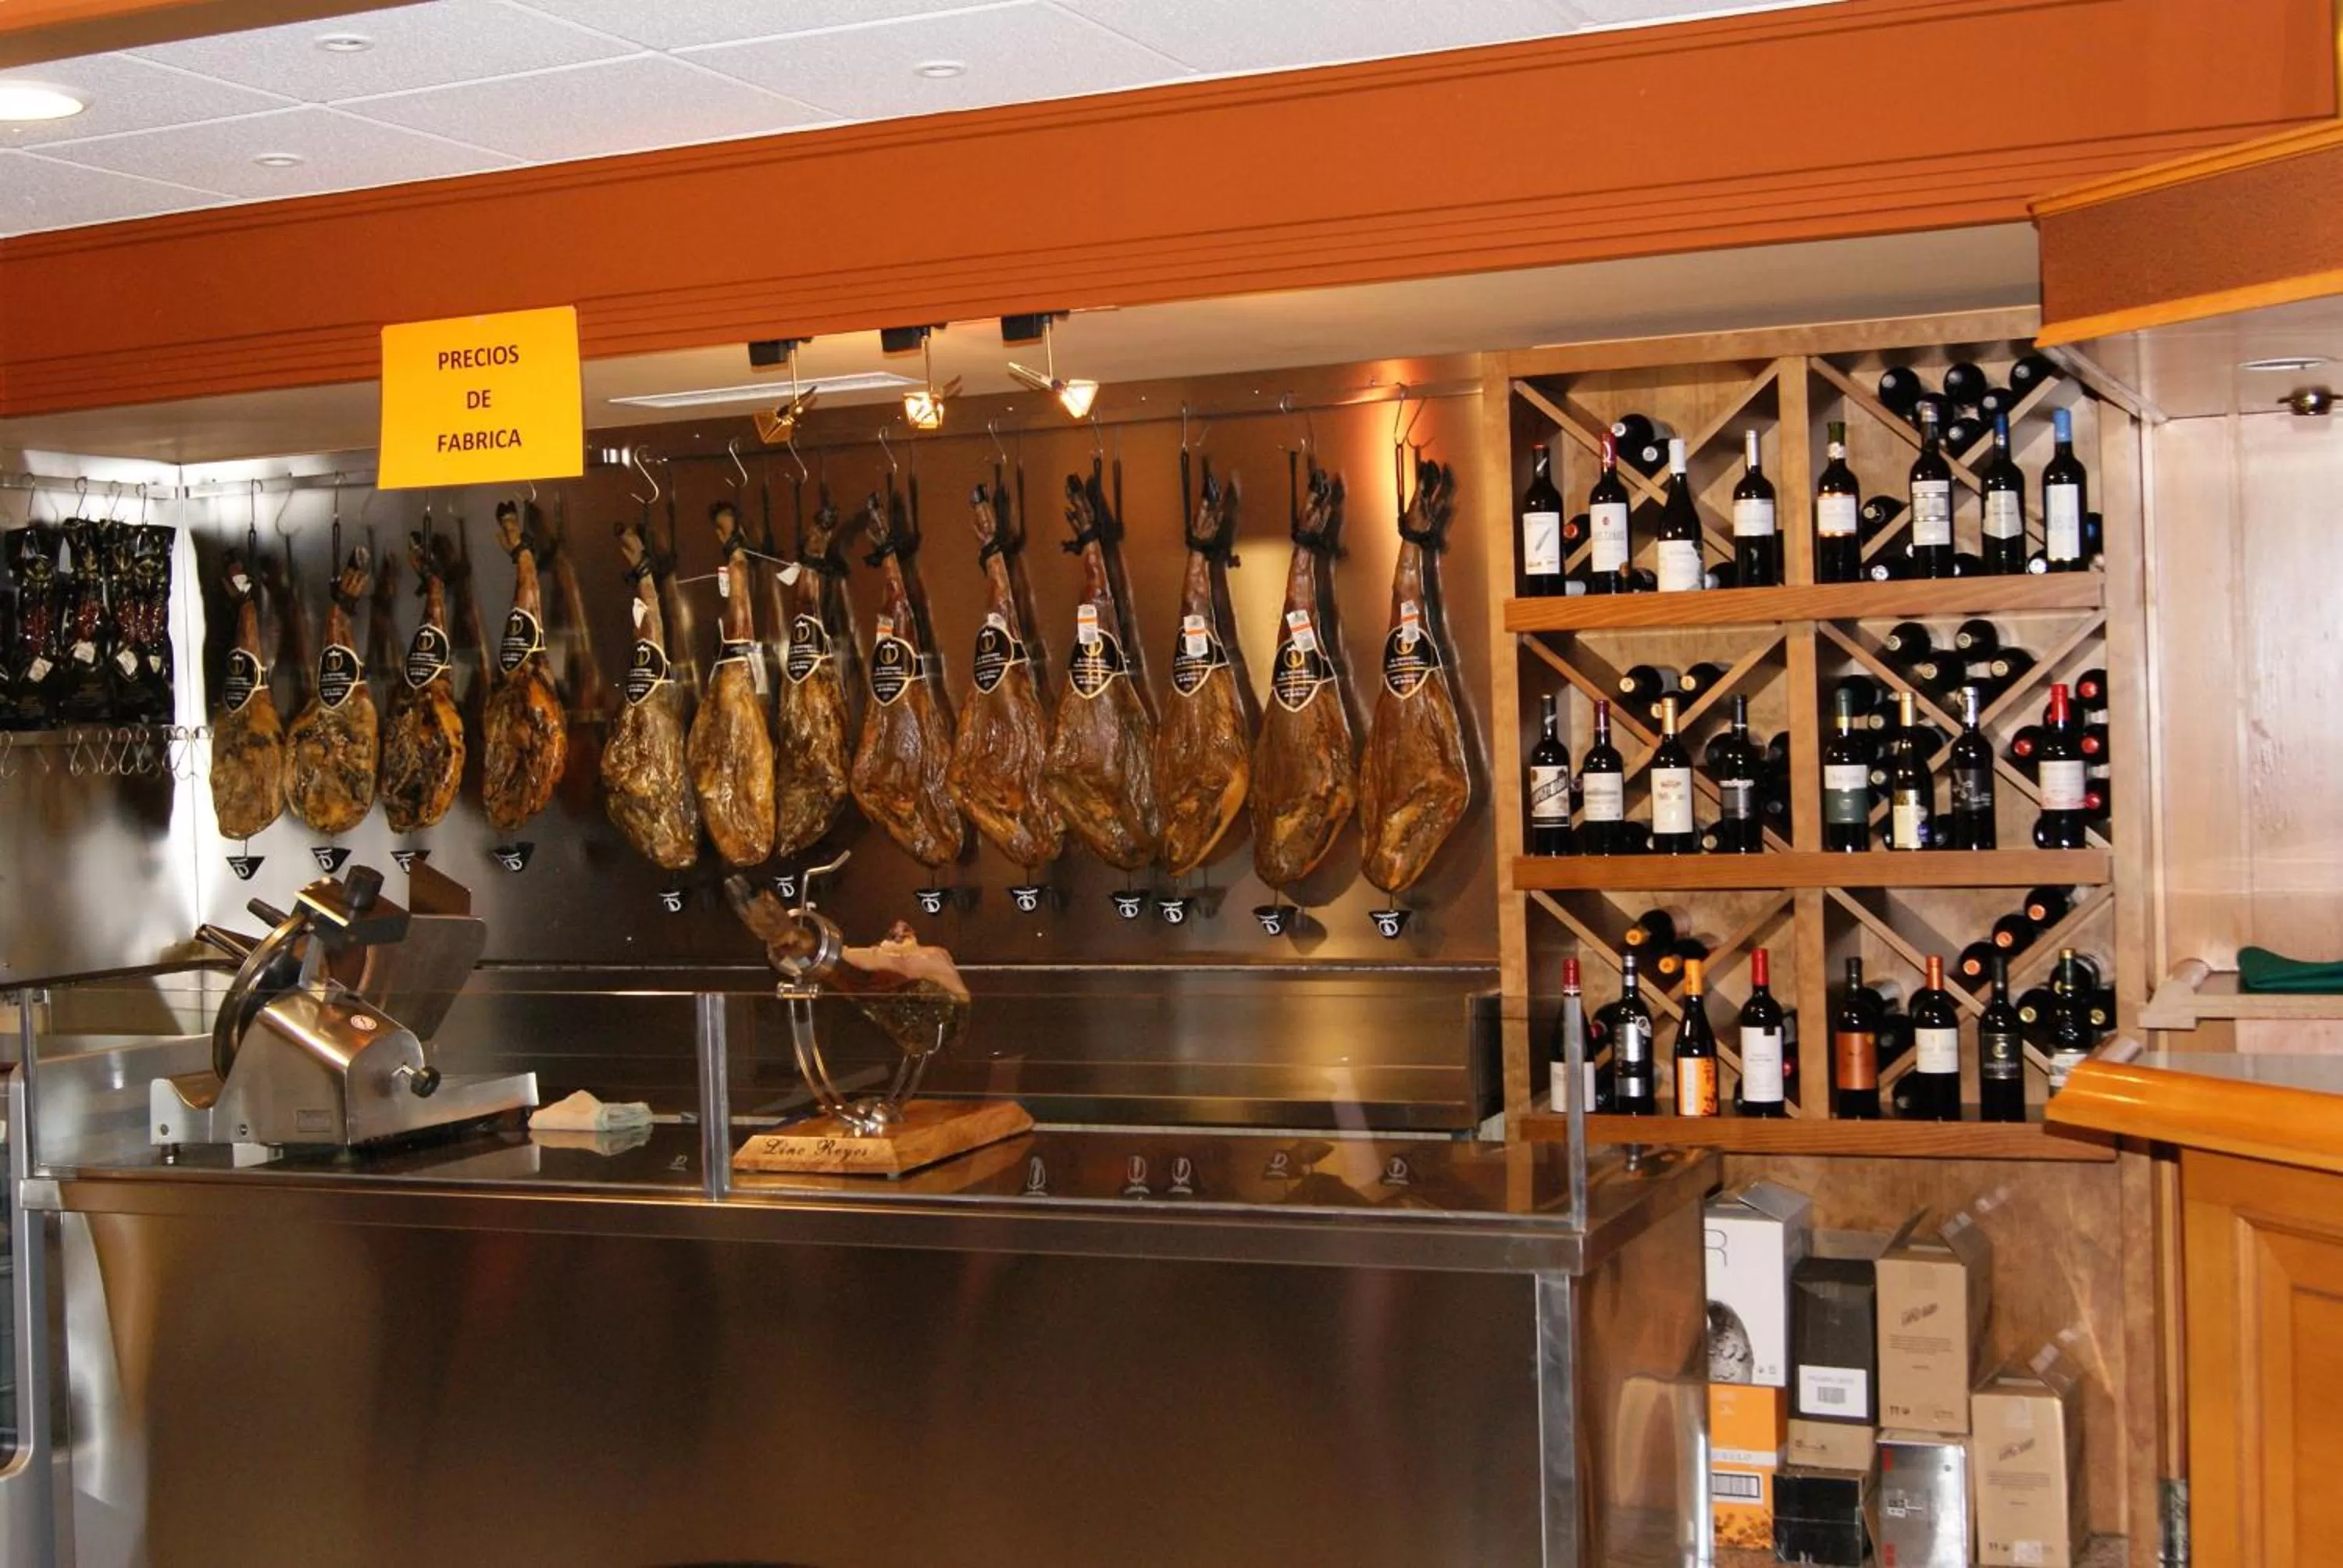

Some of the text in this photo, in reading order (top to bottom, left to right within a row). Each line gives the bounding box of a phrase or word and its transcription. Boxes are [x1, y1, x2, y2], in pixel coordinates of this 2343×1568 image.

[437, 344, 519, 371] PRECIOS
[466, 390, 491, 409] DE
[437, 429, 522, 453] FABRICA
